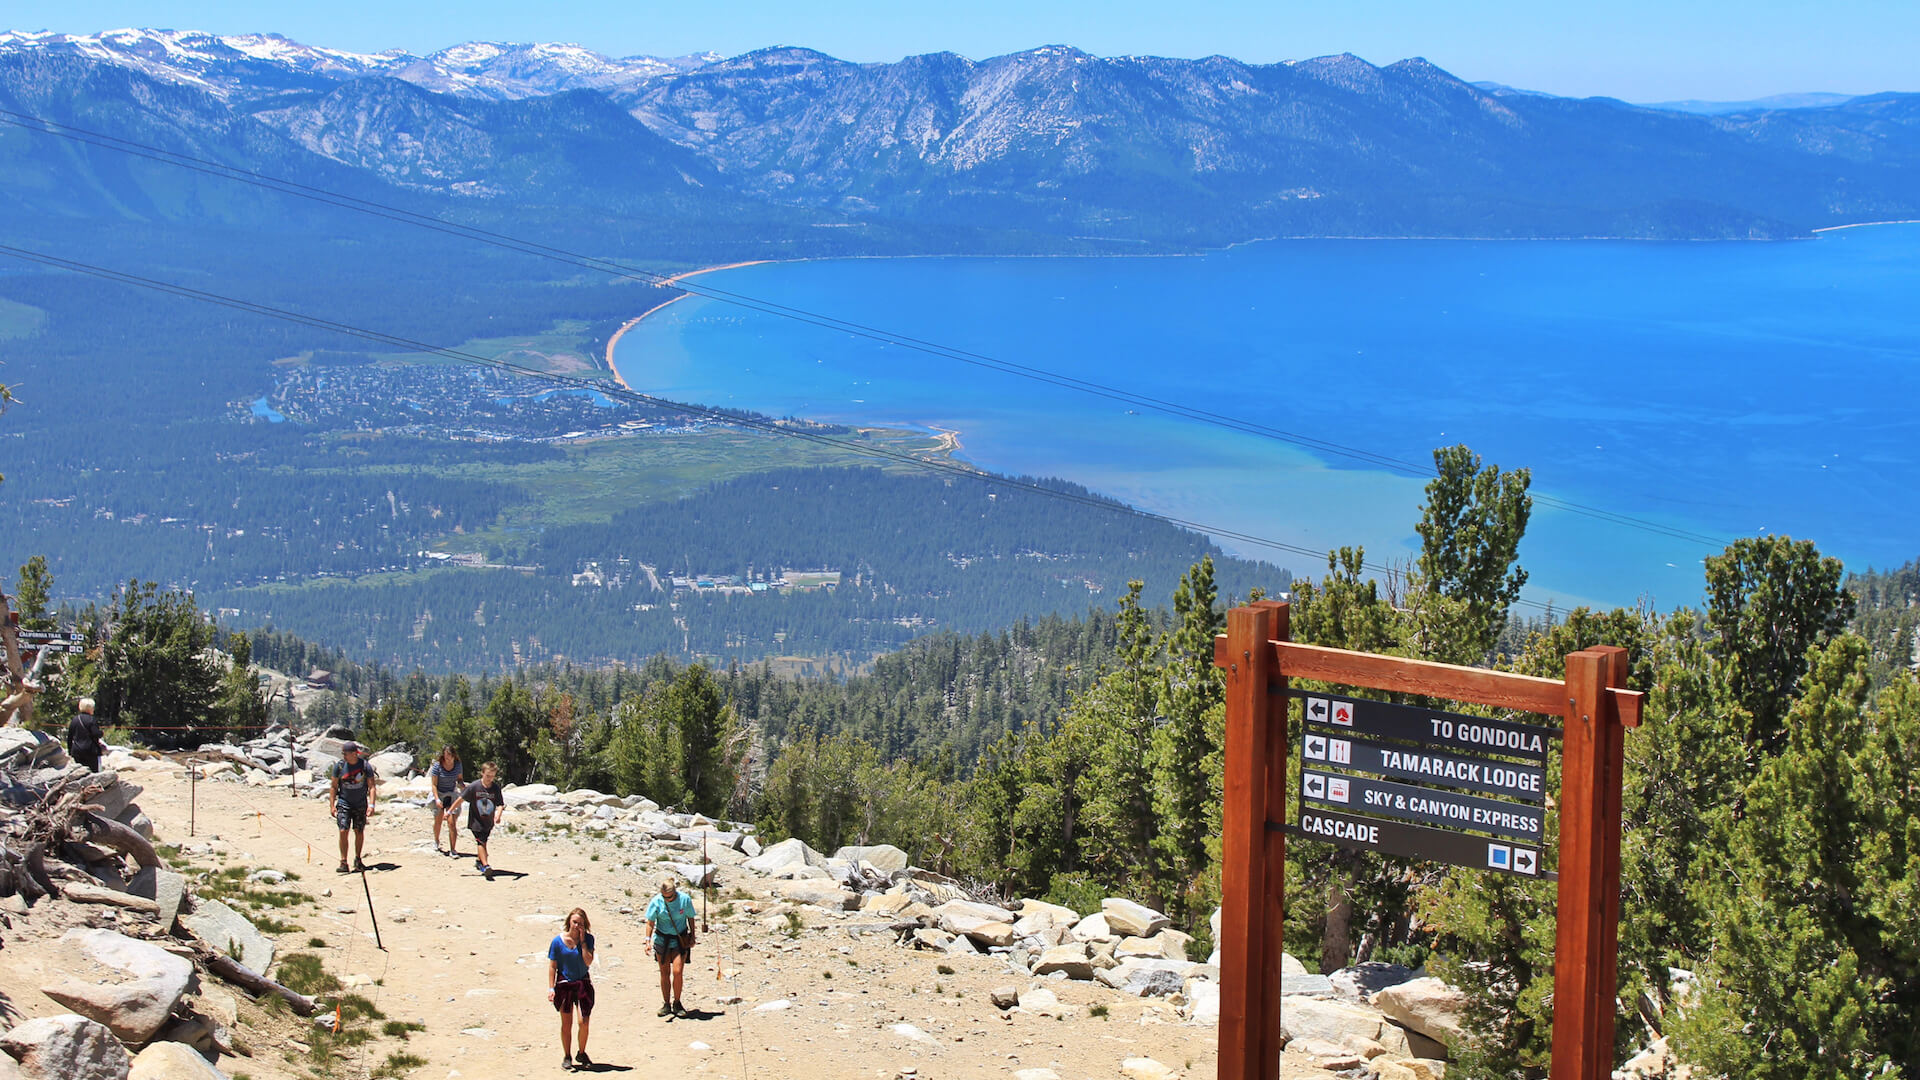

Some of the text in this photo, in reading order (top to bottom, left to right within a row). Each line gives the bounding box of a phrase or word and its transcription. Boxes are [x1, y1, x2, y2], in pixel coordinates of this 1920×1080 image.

[1431, 719, 1543, 753] TO GONDOLA
[1380, 749, 1540, 793] TAMARACK LODGE
[1302, 815, 1379, 844] CASCADE
[1364, 790, 1538, 833] SKY & CANYON EXPRESS
